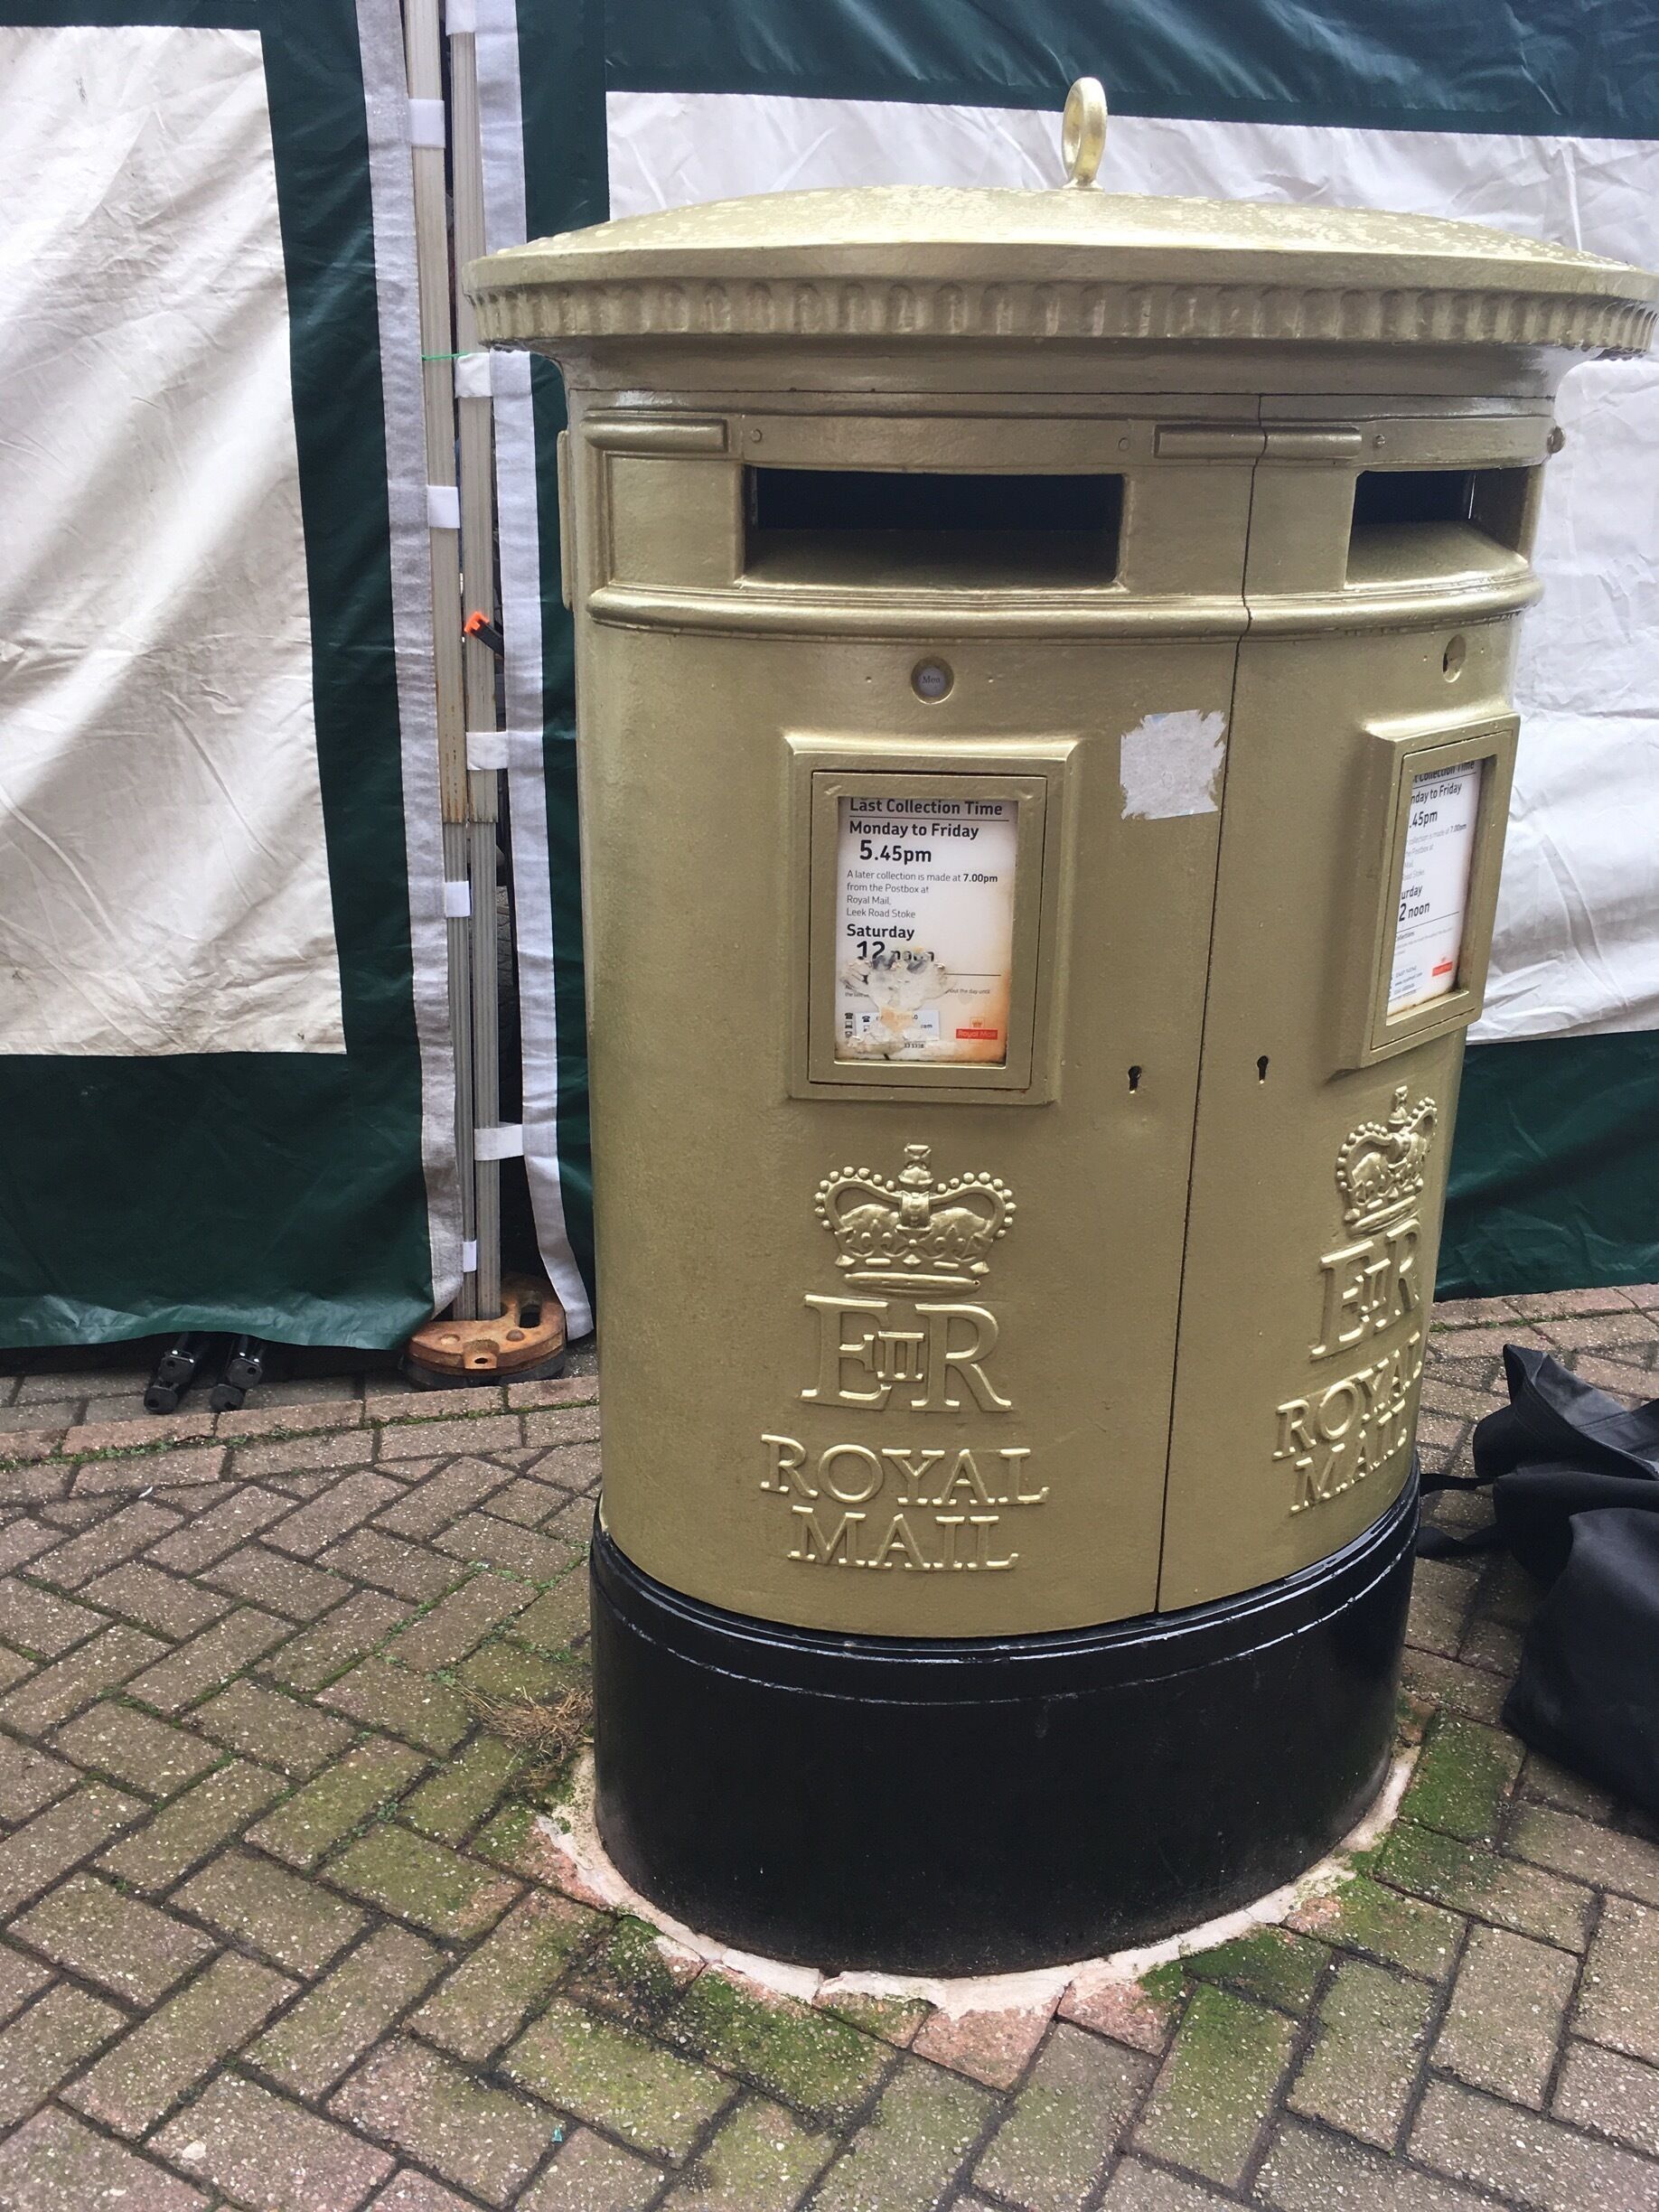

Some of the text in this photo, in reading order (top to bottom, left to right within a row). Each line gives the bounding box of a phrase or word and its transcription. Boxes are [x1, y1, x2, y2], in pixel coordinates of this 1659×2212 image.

[1430, 789, 1438, 799] to
[1439, 783, 1462, 797] Friday
[850, 797, 1003, 815] Last Collection Time
[849, 820, 979, 839] Monday to Friday
[859, 839, 932, 865] 5.45pm
[847, 870, 998, 884] A later collection is made at 7.00pm
[847, 882, 929, 894] from the Postbox at
[847, 895, 870, 905] Royal
[846, 907, 916, 919] Leek Road Stoke
[1408, 903, 1430, 919] noon
[846, 923, 915, 941] Saturday
[856, 941, 886, 961] 12
[1272, 1331, 1422, 1461] ROYAL
[1289, 1399, 1407, 1517] MAIL
[760, 1433, 1050, 1506] ROYAL
[787, 1504, 1019, 1571] MAIL
